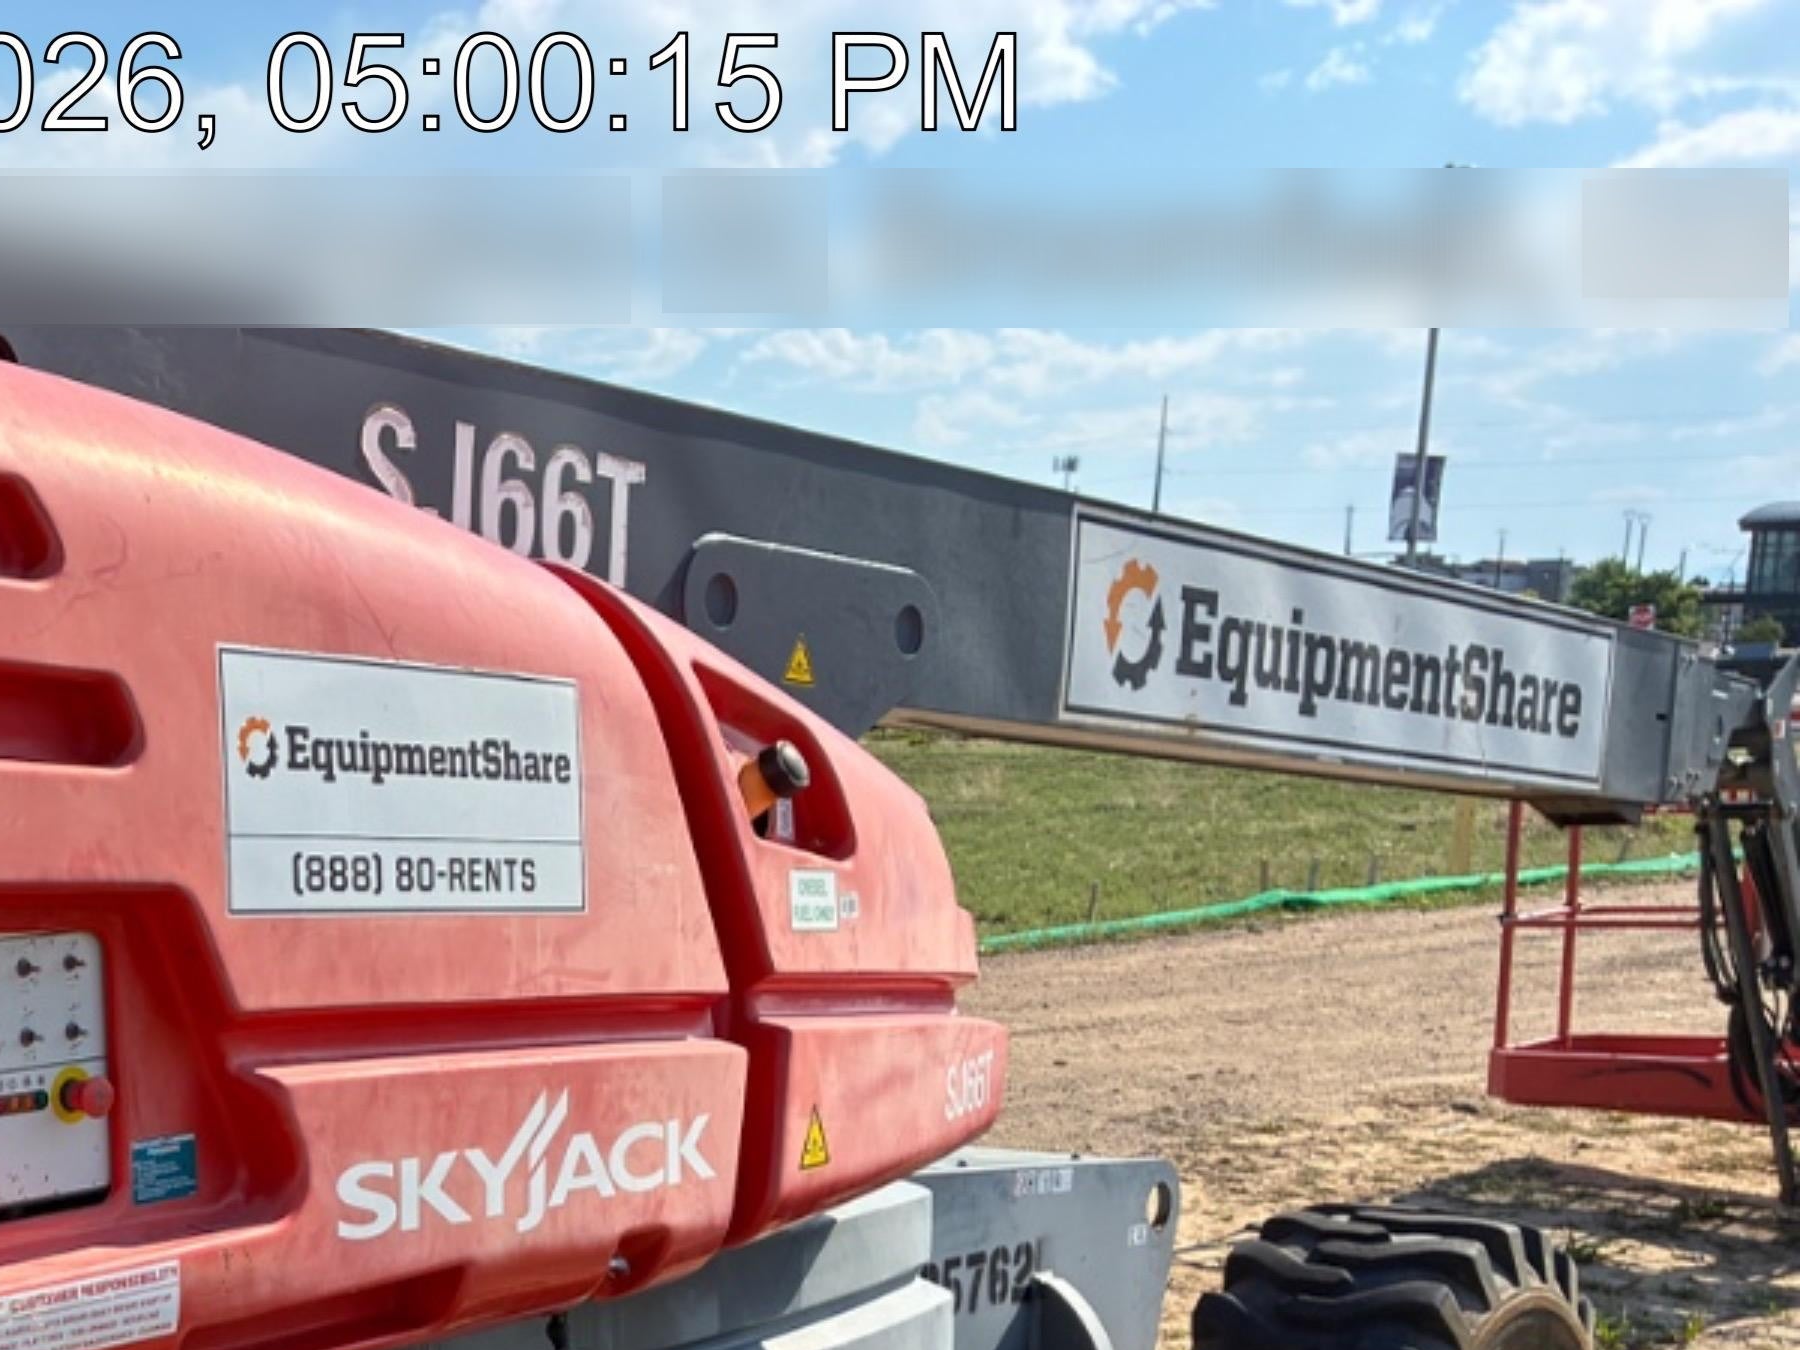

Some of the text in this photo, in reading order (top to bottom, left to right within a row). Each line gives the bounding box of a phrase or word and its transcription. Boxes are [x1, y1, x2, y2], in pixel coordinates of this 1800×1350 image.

[1175, 584, 1583, 738] EquipmentShare
[284, 725, 572, 784] EquipmentShare
[292, 851, 537, 895] (888) 80-RENTS
[335, 1087, 716, 1241] SKYJACK
